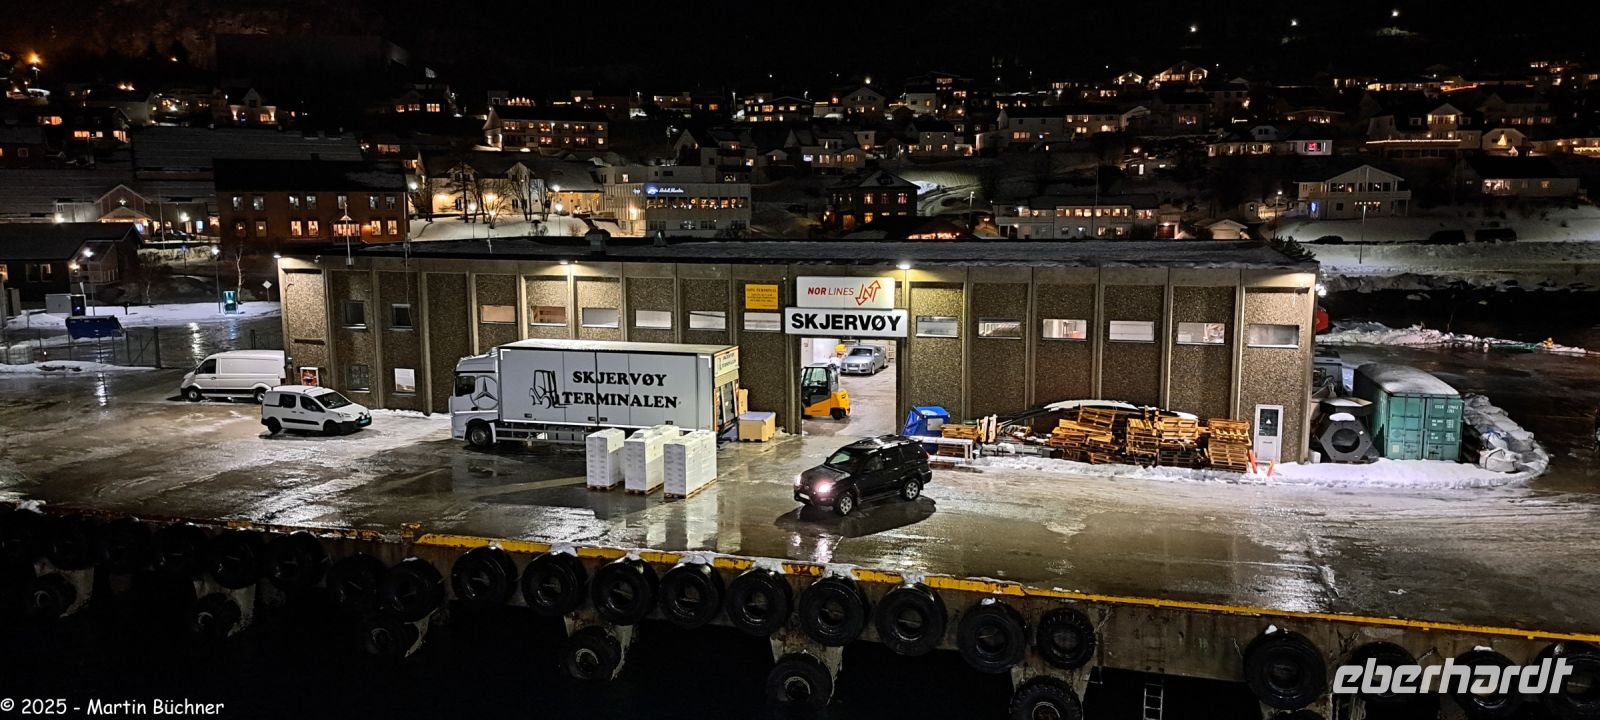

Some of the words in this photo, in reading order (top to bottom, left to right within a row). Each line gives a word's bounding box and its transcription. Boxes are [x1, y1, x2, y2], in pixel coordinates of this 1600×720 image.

[808, 287, 827, 295] NOR
[828, 287, 854, 296] LINES
[791, 312, 902, 332] SKJERVØY
[572, 370, 667, 387] SKJERVØY
[561, 391, 678, 409] TERMINALEN
